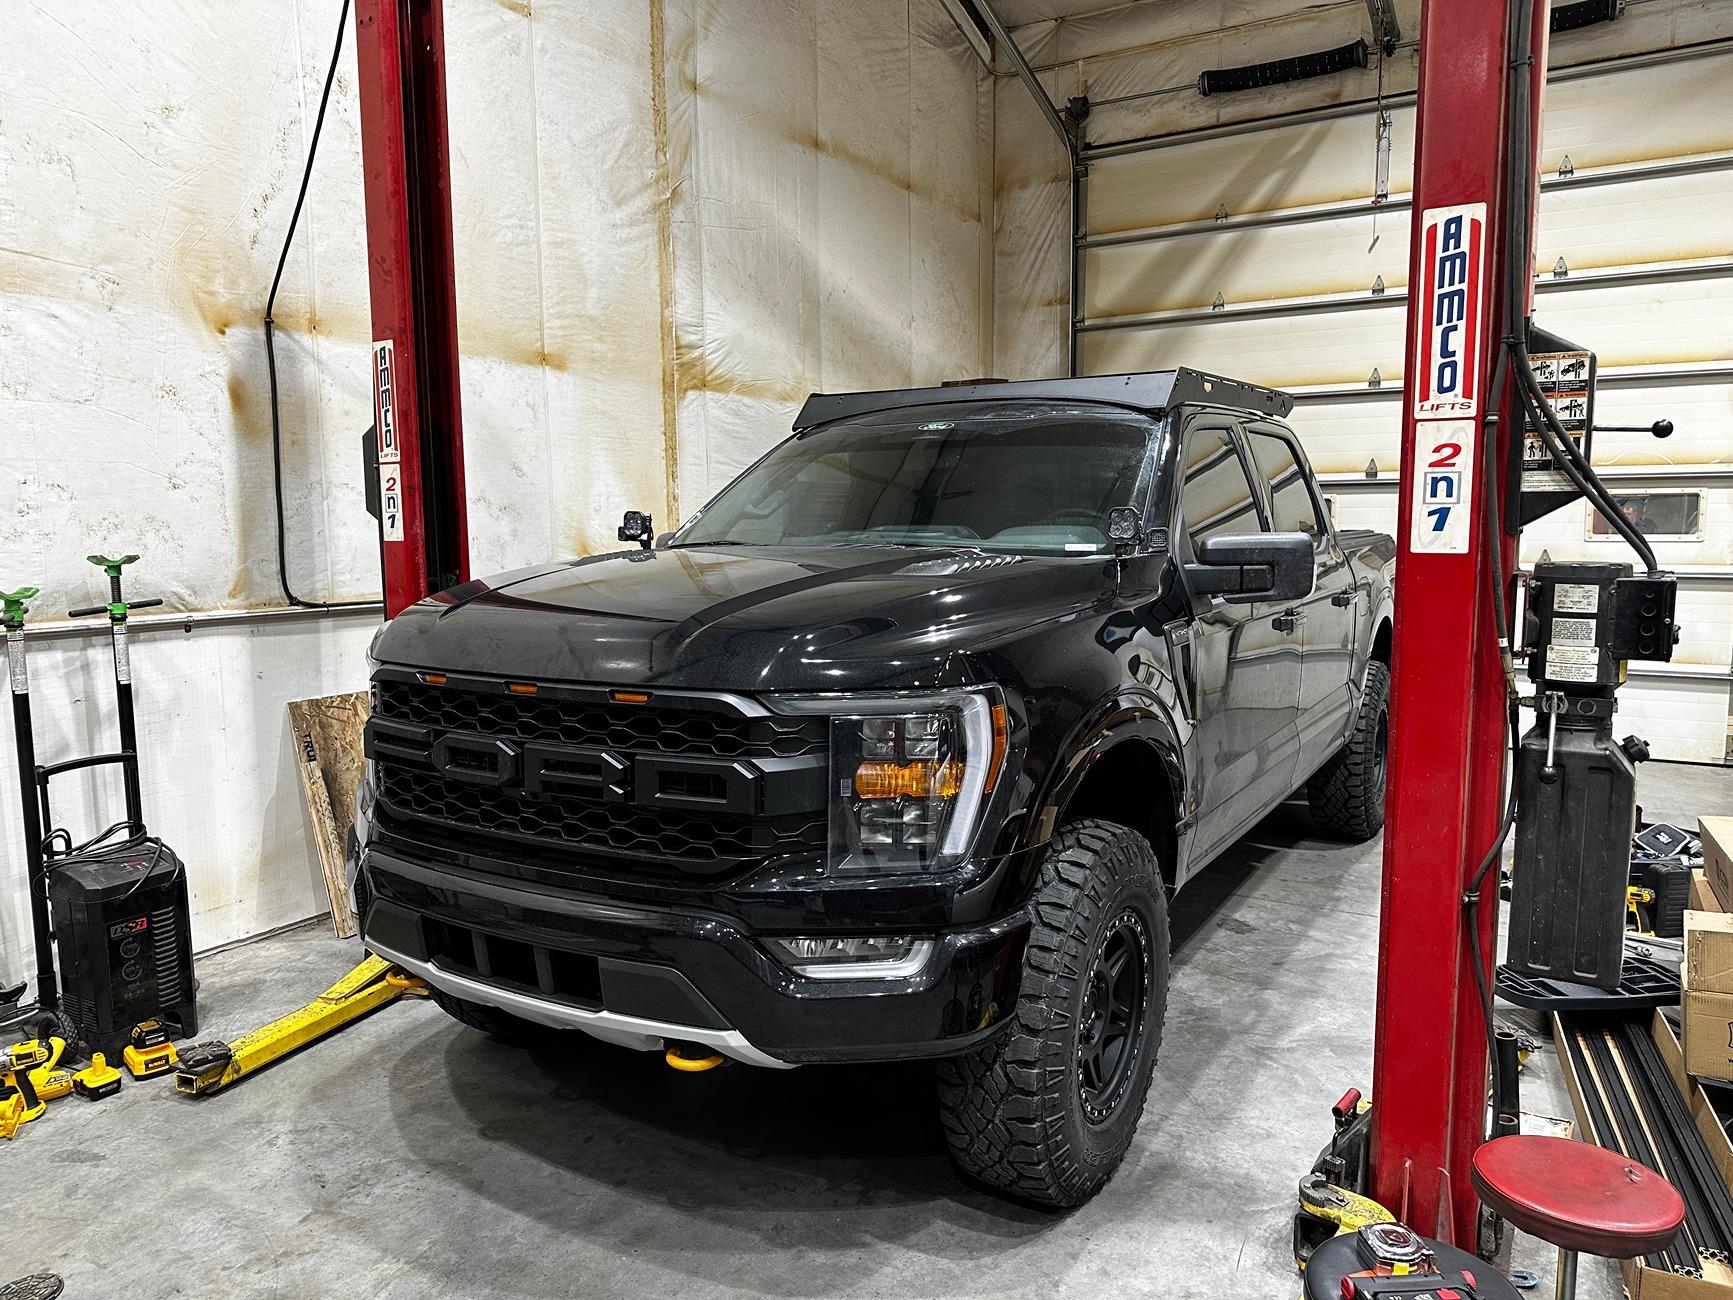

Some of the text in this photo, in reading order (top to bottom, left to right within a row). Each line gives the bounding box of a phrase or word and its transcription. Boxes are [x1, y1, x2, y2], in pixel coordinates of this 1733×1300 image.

[1435, 214, 1467, 395] AMMCO
[379, 346, 392, 448] AMMCO
[1419, 401, 1472, 412] LIFTS
[364, 716, 762, 815] FORD
